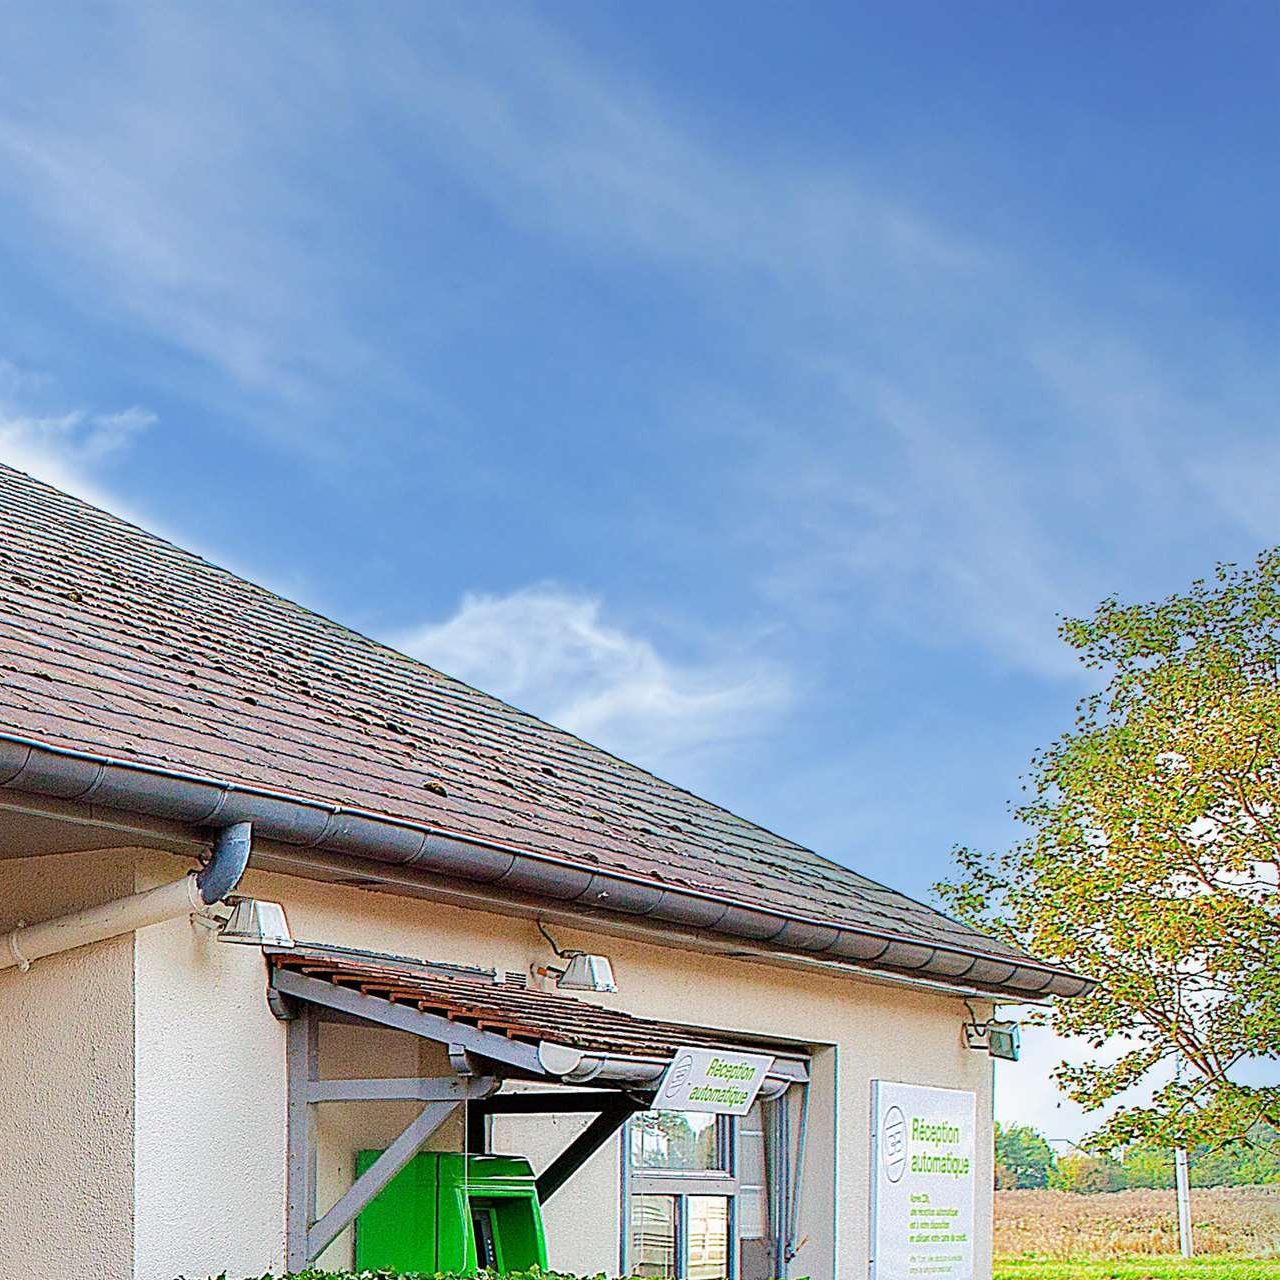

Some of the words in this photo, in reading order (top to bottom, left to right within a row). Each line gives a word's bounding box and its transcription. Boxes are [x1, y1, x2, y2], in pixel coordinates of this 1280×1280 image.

[705, 1058, 756, 1082] Réception
[688, 1084, 749, 1107] automatique
[912, 1117, 959, 1148] Réception
[911, 1151, 969, 1179] automatique
